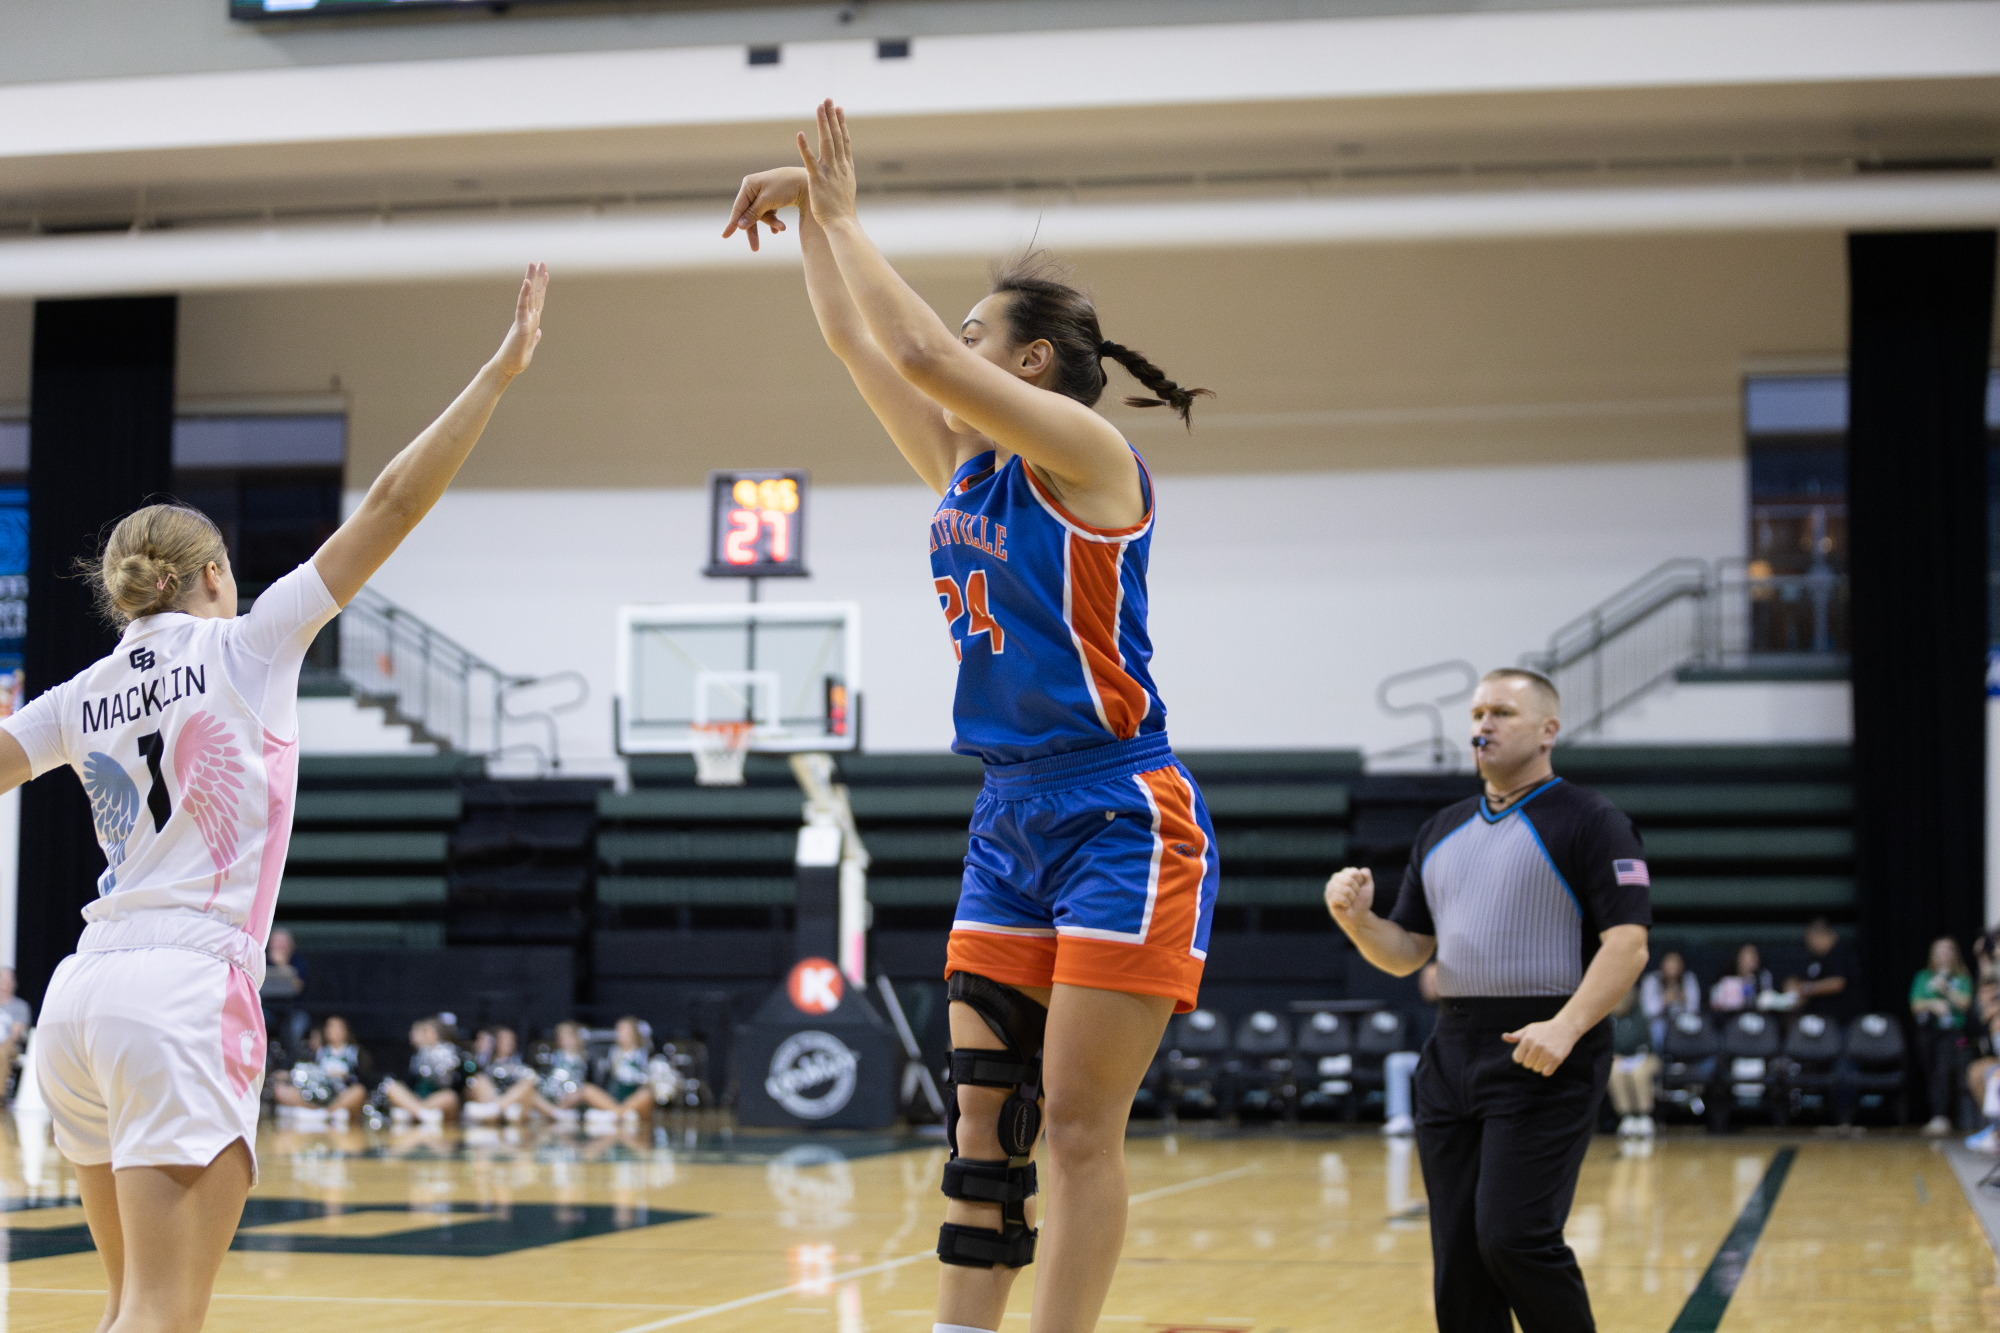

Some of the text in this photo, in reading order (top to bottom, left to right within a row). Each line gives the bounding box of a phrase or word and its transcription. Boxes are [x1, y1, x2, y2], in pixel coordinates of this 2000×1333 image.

[725, 509, 789, 565] 27
[930, 508, 1007, 562] TTEVILLE
[933, 569, 1005, 665] 24
[129, 647, 156, 673] GB
[82, 664, 206, 734] MACKLIN
[137, 728, 172, 834] 1
[800, 967, 840, 1012] K
